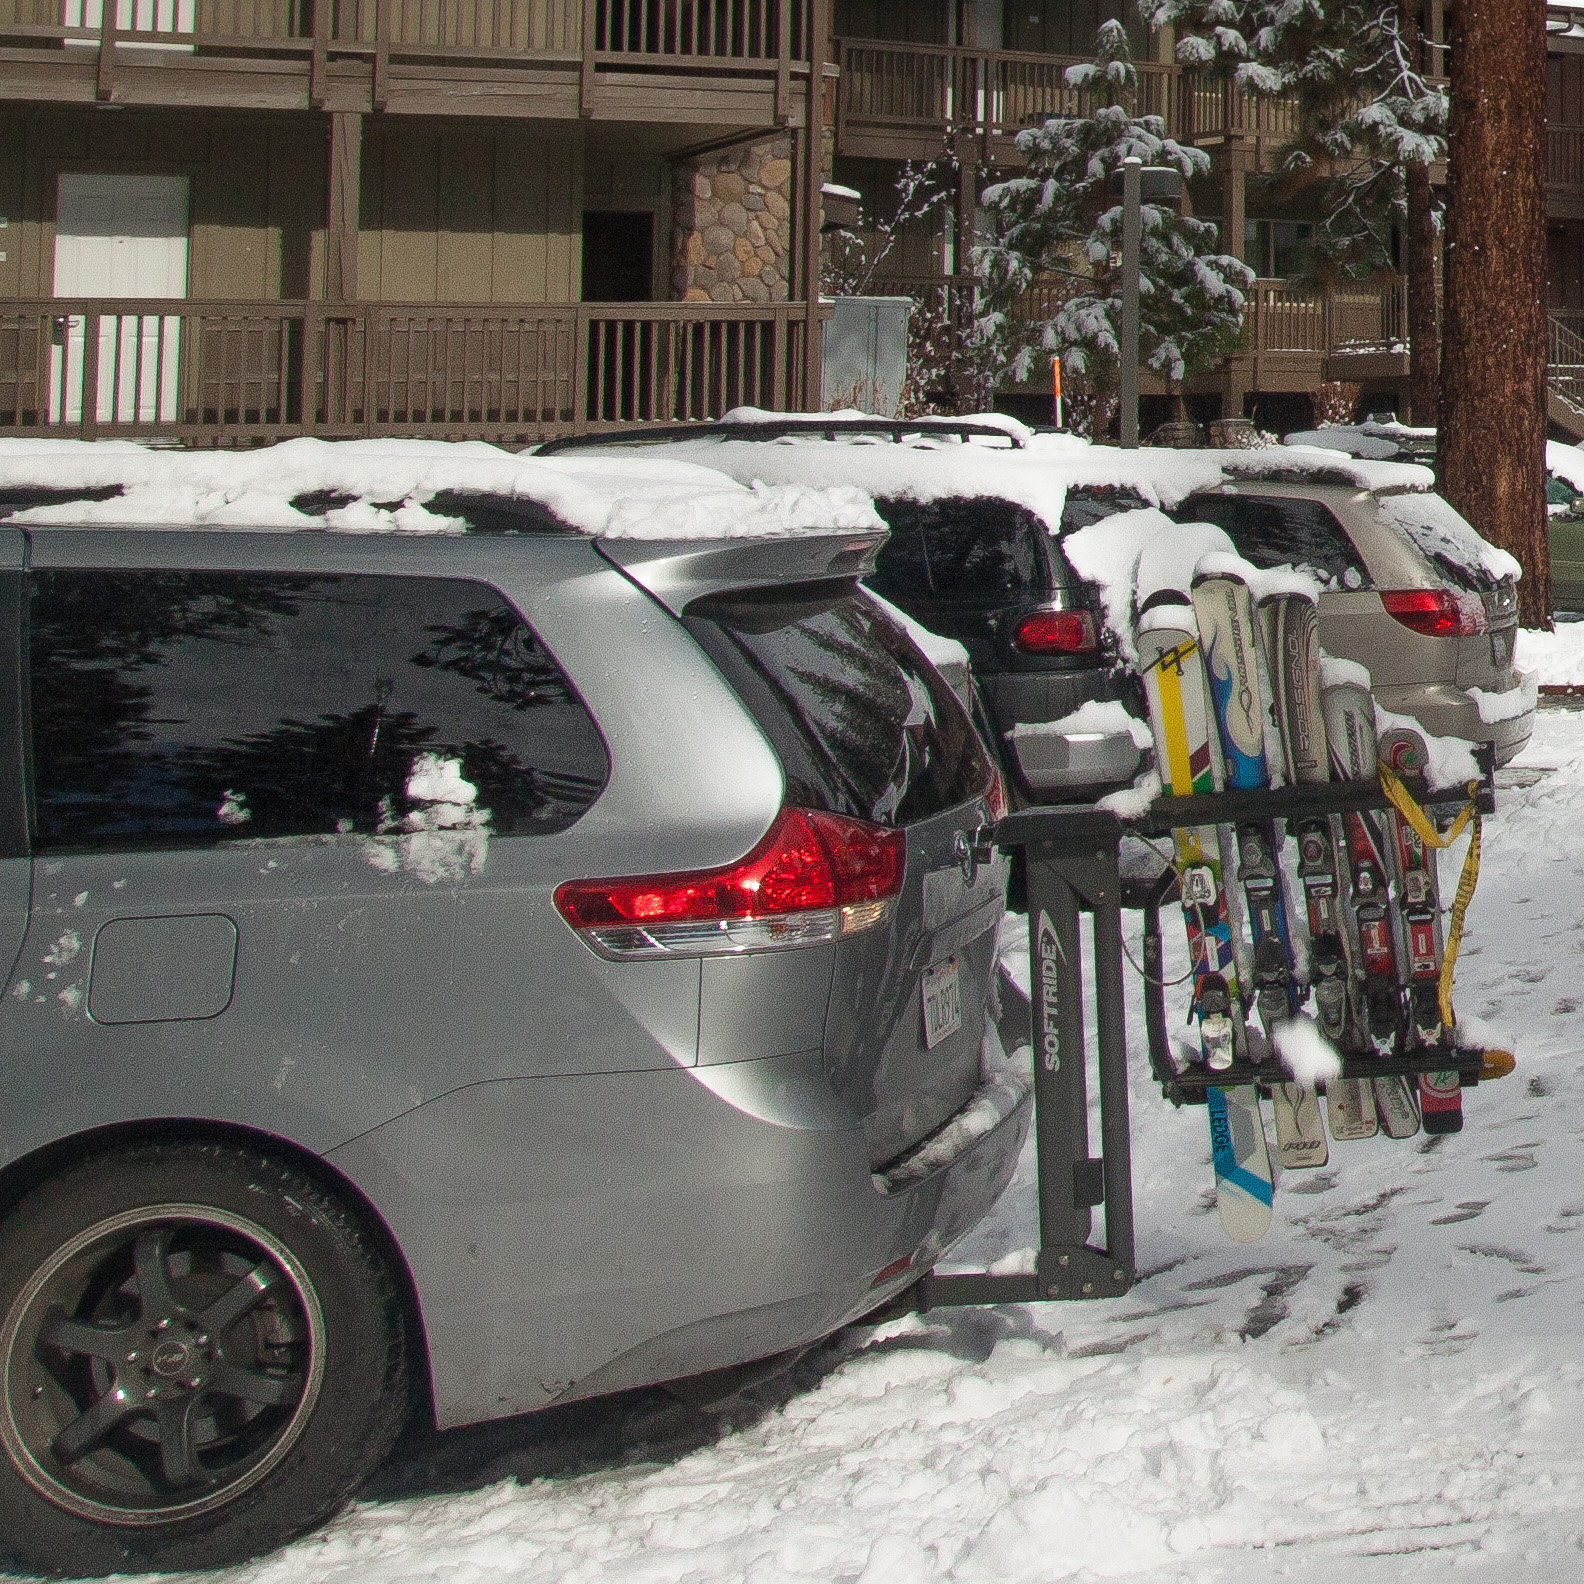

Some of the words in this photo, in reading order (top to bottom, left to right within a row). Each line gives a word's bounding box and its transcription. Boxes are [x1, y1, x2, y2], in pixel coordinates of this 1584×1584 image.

[1288, 629, 1311, 752] ROSSIGNOL
[1041, 942, 1060, 1072] SOFTRIDE
[1211, 1108, 1229, 1152] LEDGE
